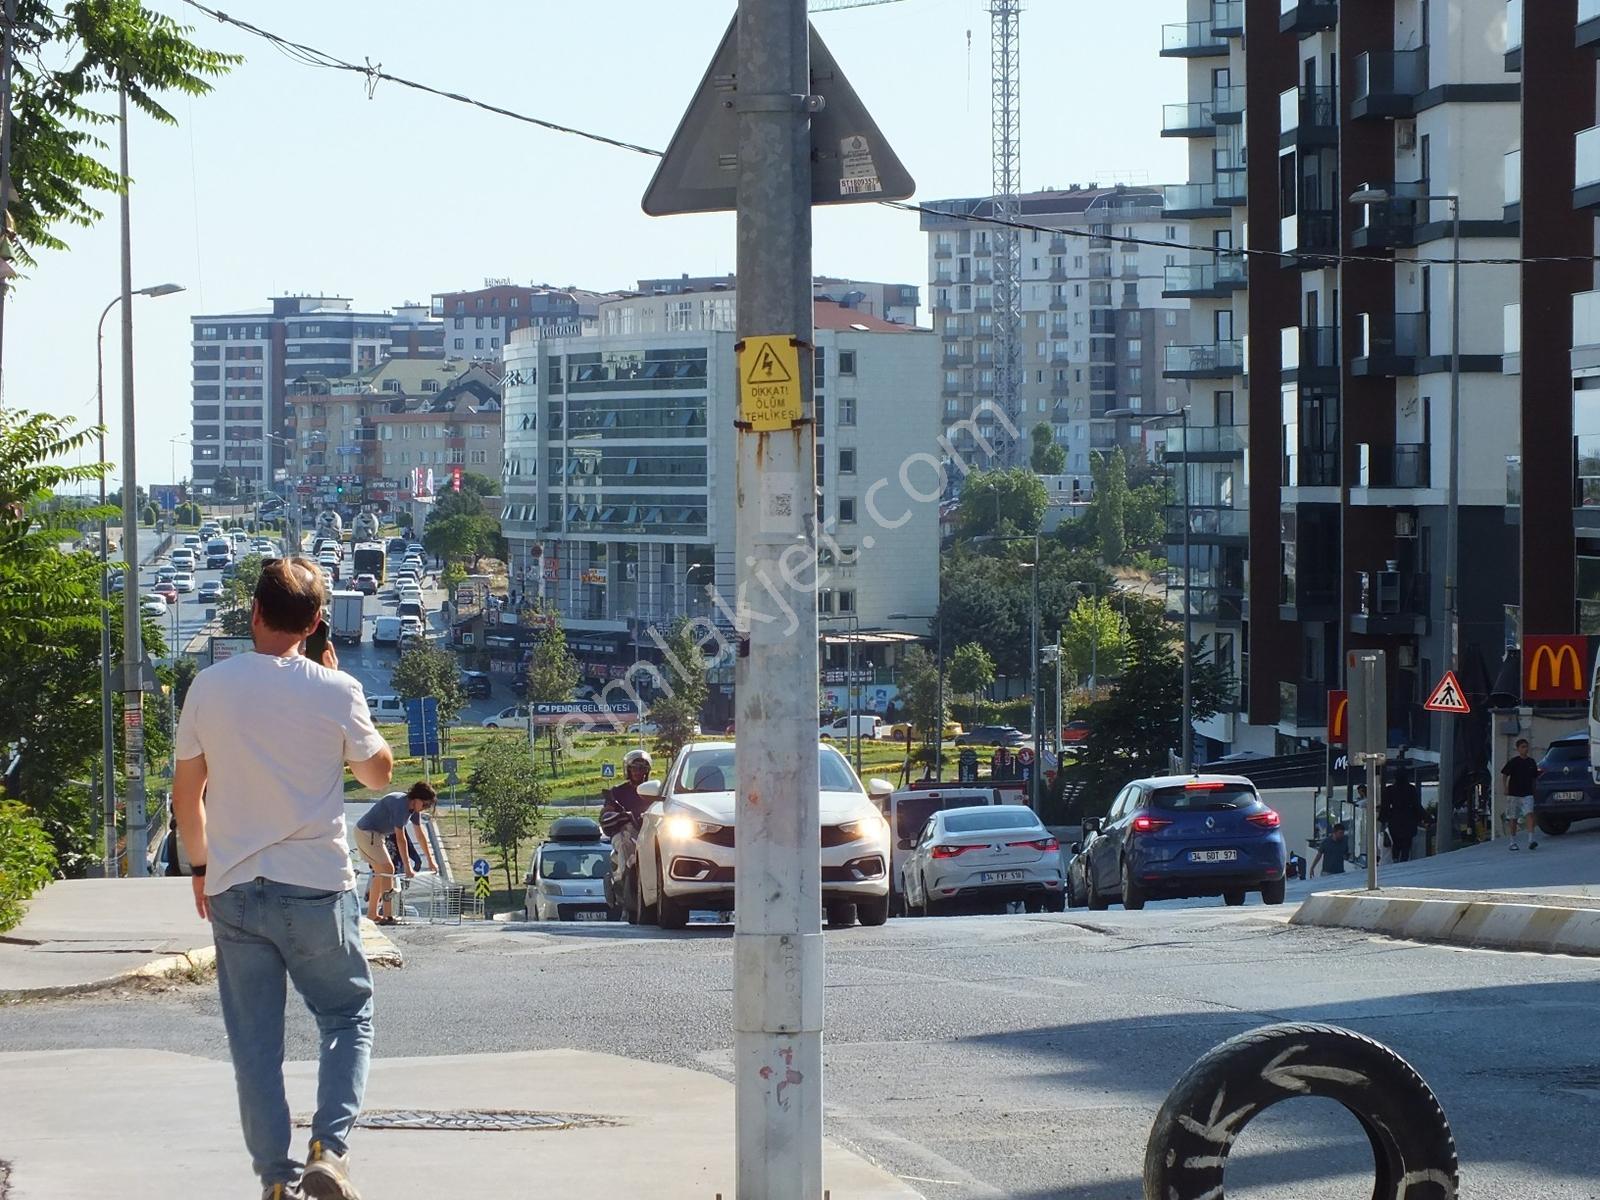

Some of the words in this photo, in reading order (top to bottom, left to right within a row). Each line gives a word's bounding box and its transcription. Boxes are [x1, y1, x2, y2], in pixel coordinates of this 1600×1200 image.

[751, 386, 788, 397] DİKKAT!
[755, 397, 786, 409] ÖLÜM
[1192, 852, 1200, 861] 34
[1223, 850, 1236, 860] 971
